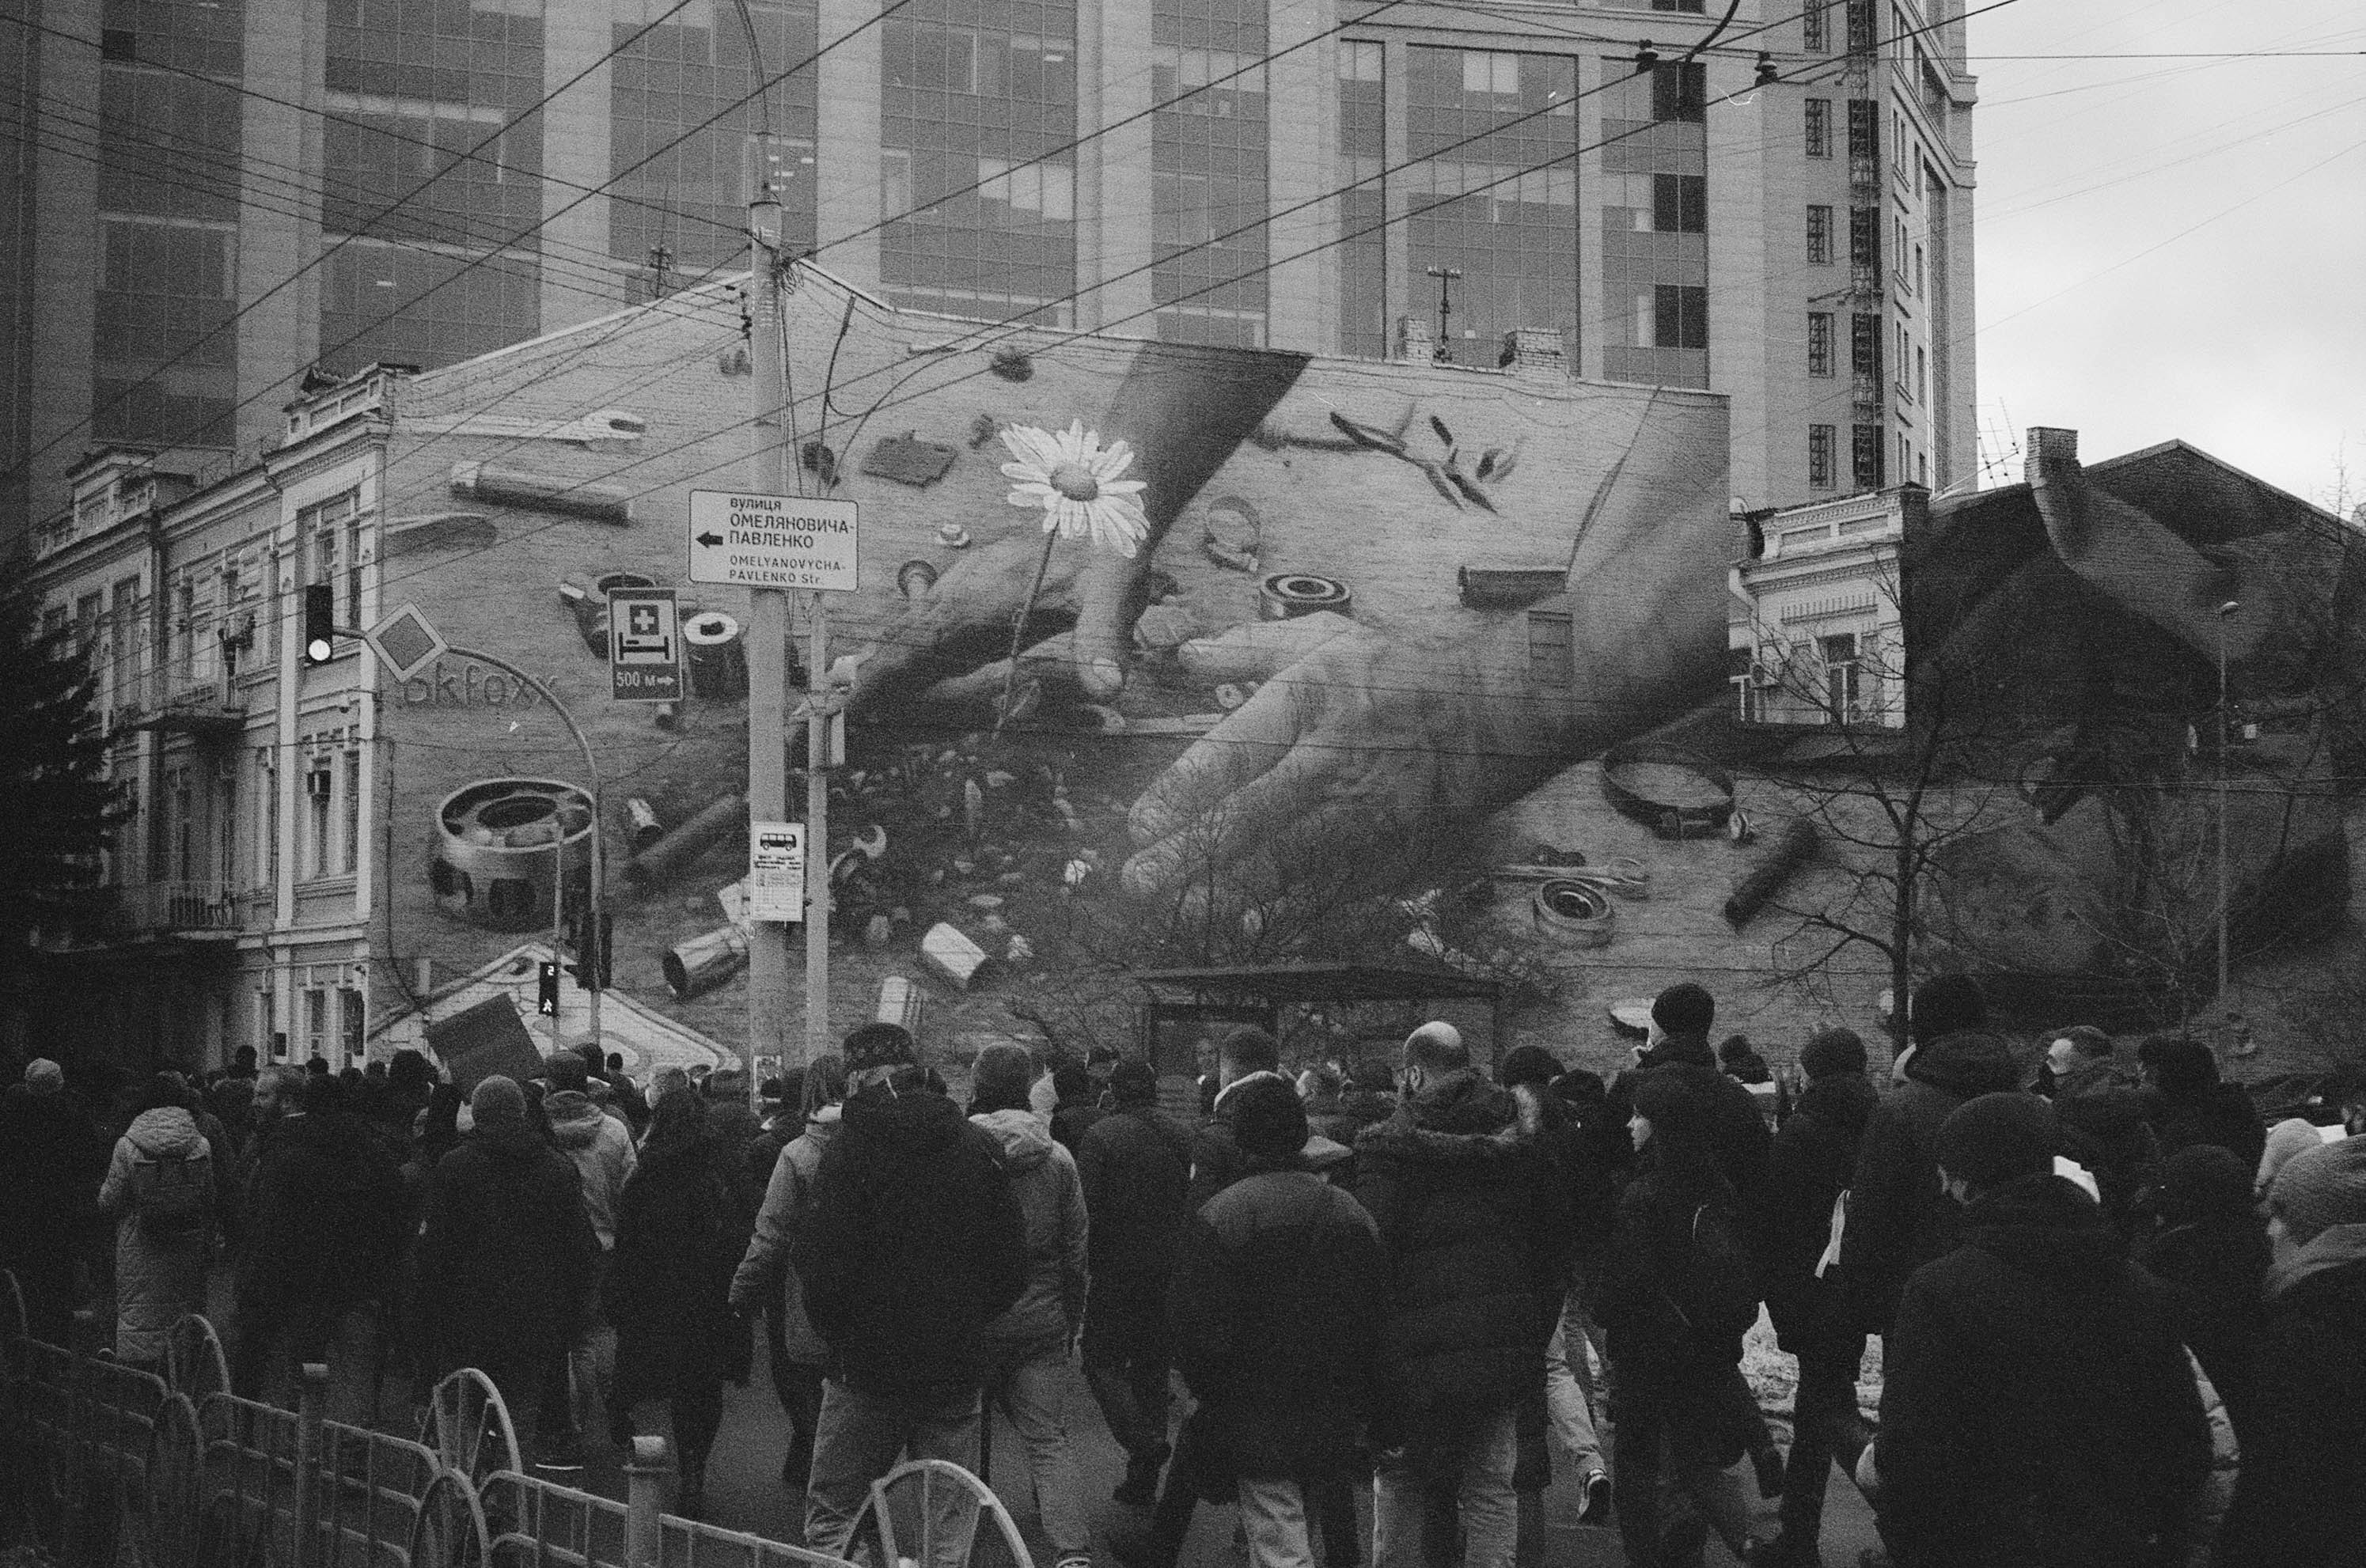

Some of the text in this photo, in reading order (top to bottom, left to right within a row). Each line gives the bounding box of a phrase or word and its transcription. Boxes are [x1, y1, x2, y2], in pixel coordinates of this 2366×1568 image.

[730, 498, 782, 512] вулиця
[730, 513, 855, 533] ОМЕЛЯНОВИЧА-
[729, 530, 813, 548] ПАВЛЕНКО
[730, 555, 846, 570] OMELYANOVYCHA-
[729, 570, 796, 583] PAVLENKO
[616, 671, 640, 687] 500
[548, 965, 555, 976] 2
